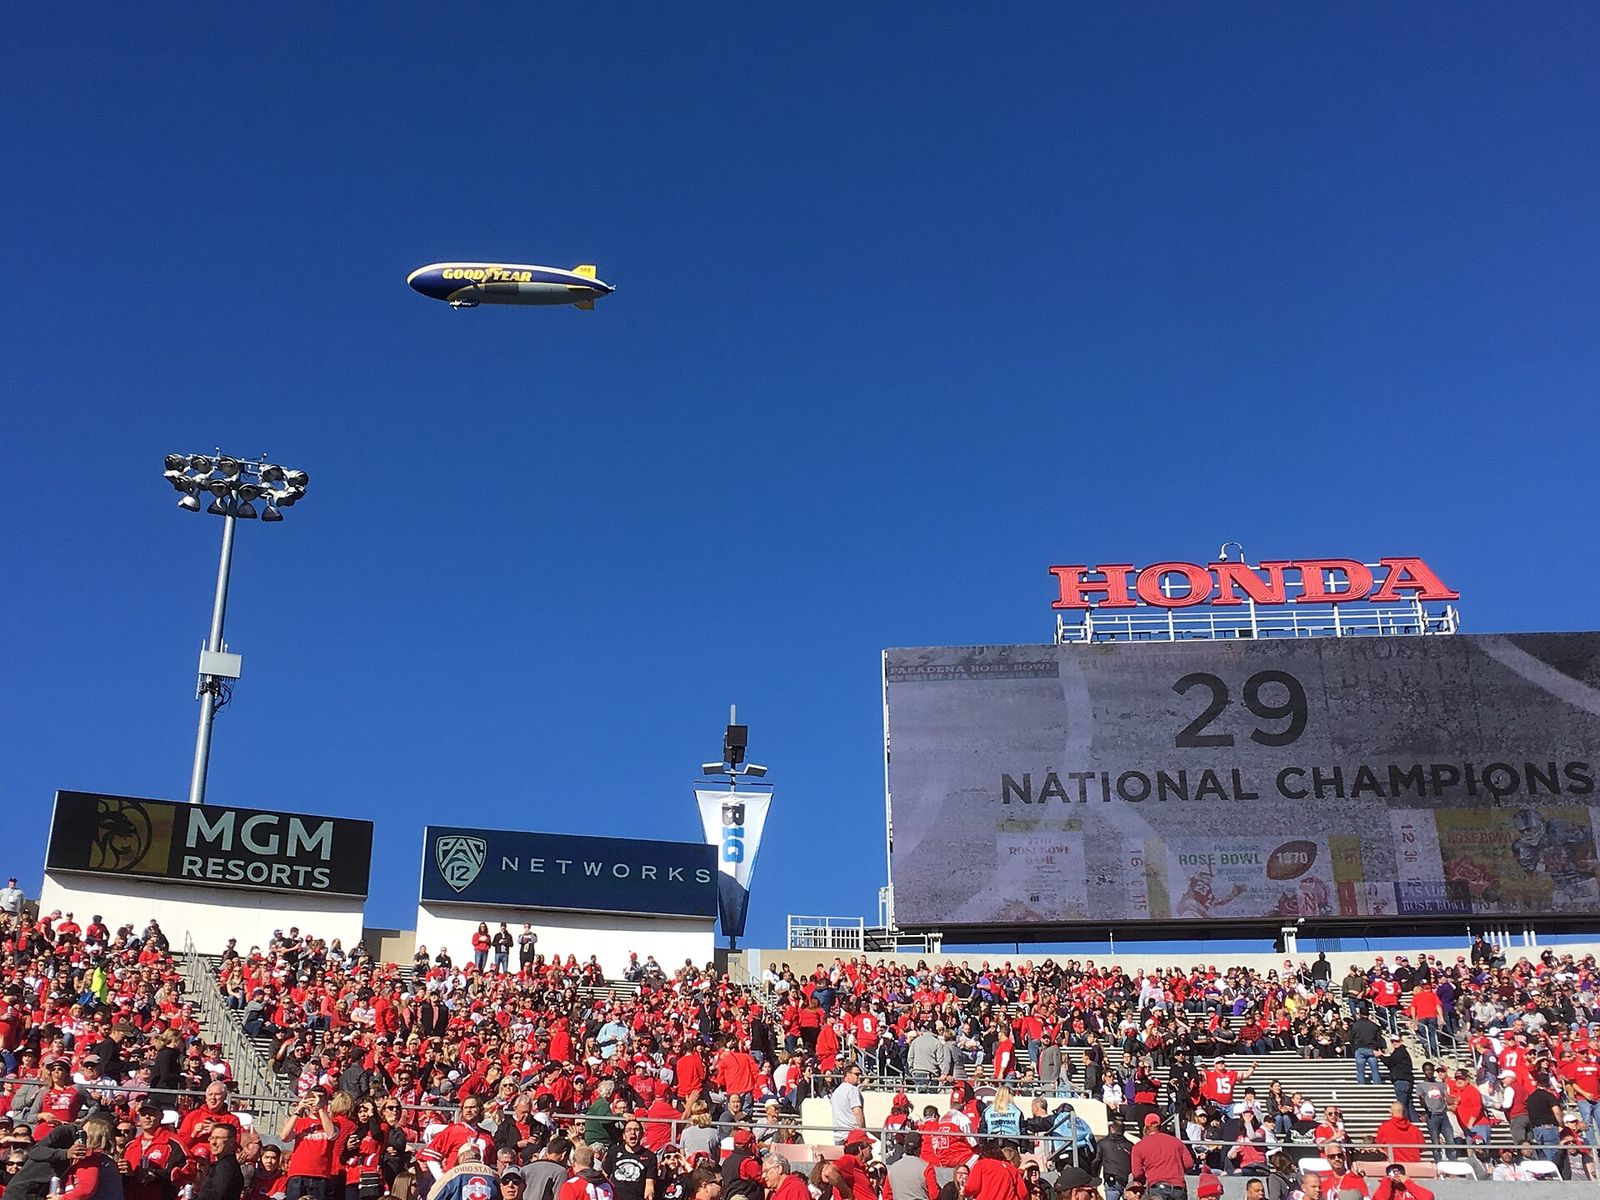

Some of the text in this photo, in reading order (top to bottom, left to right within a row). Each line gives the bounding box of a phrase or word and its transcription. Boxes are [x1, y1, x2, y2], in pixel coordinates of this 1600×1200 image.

[1049, 557, 1460, 609] HONDA
[890, 662, 1056, 675] PASADENA ROSE BOWL
[1171, 669, 1308, 748] 29
[1001, 761, 1596, 805] NATIONAL CHAMPIONS
[185, 807, 334, 860] MGM
[1178, 852, 1263, 866] ROSE BOWL
[181, 856, 331, 889] RESORTS
[451, 865, 470, 881] 12
[501, 855, 711, 884] NETWORKS
[1403, 900, 1433, 911] ROSE
[1386, 982, 1395, 995] 5
[863, 1018, 873, 1033] 8
[1216, 1077, 1232, 1094] 15
[454, 1166, 473, 1174] OHIO
